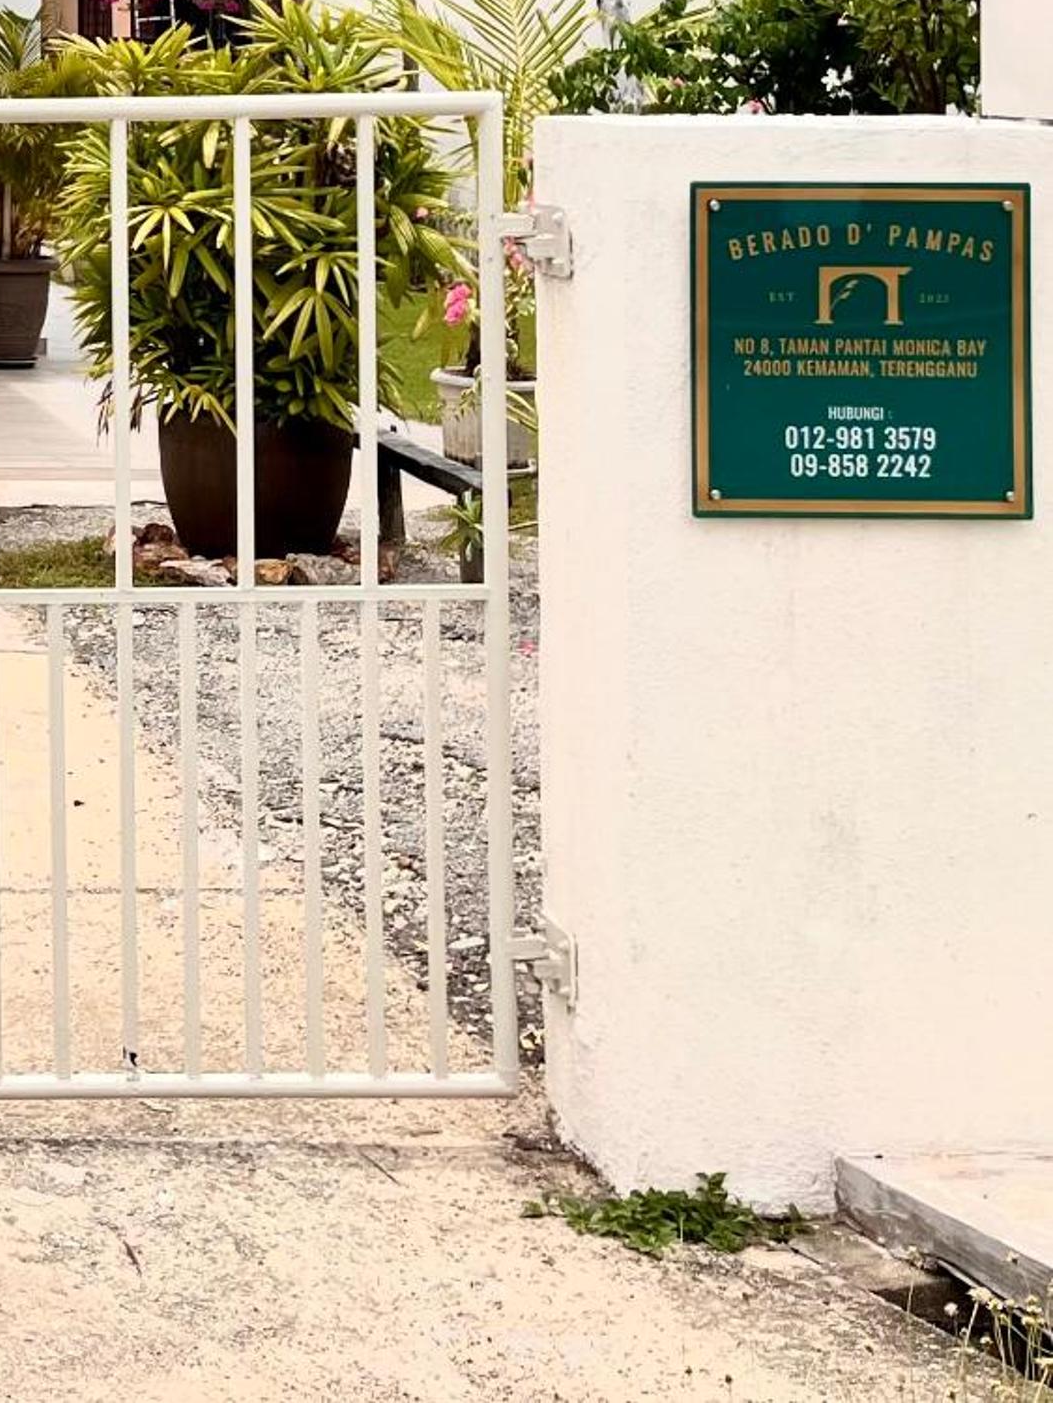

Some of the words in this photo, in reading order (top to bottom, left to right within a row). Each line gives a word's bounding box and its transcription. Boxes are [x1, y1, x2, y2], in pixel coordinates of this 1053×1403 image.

[728, 225, 831, 261] BERADO
[847, 223, 873, 245] D'
[888, 225, 995, 262] PAMPAS
[734, 338, 755, 355] NO
[760, 338, 775, 356] 8,
[778, 338, 829, 355] TAMAN
[835, 339, 887, 356] PANTAI
[893, 339, 951, 356] MONICA
[957, 339, 987, 357] BAY
[743, 360, 791, 376] 24000
[797, 360, 875, 378] KEMAMAN,
[879, 361, 978, 378] TERENGGANU
[827, 406, 884, 421] HUBUNGI
[785, 426, 875, 450] 012-981
[883, 427, 937, 451] 3579
[790, 454, 869, 478] 09-858
[876, 454, 931, 478] 2242
